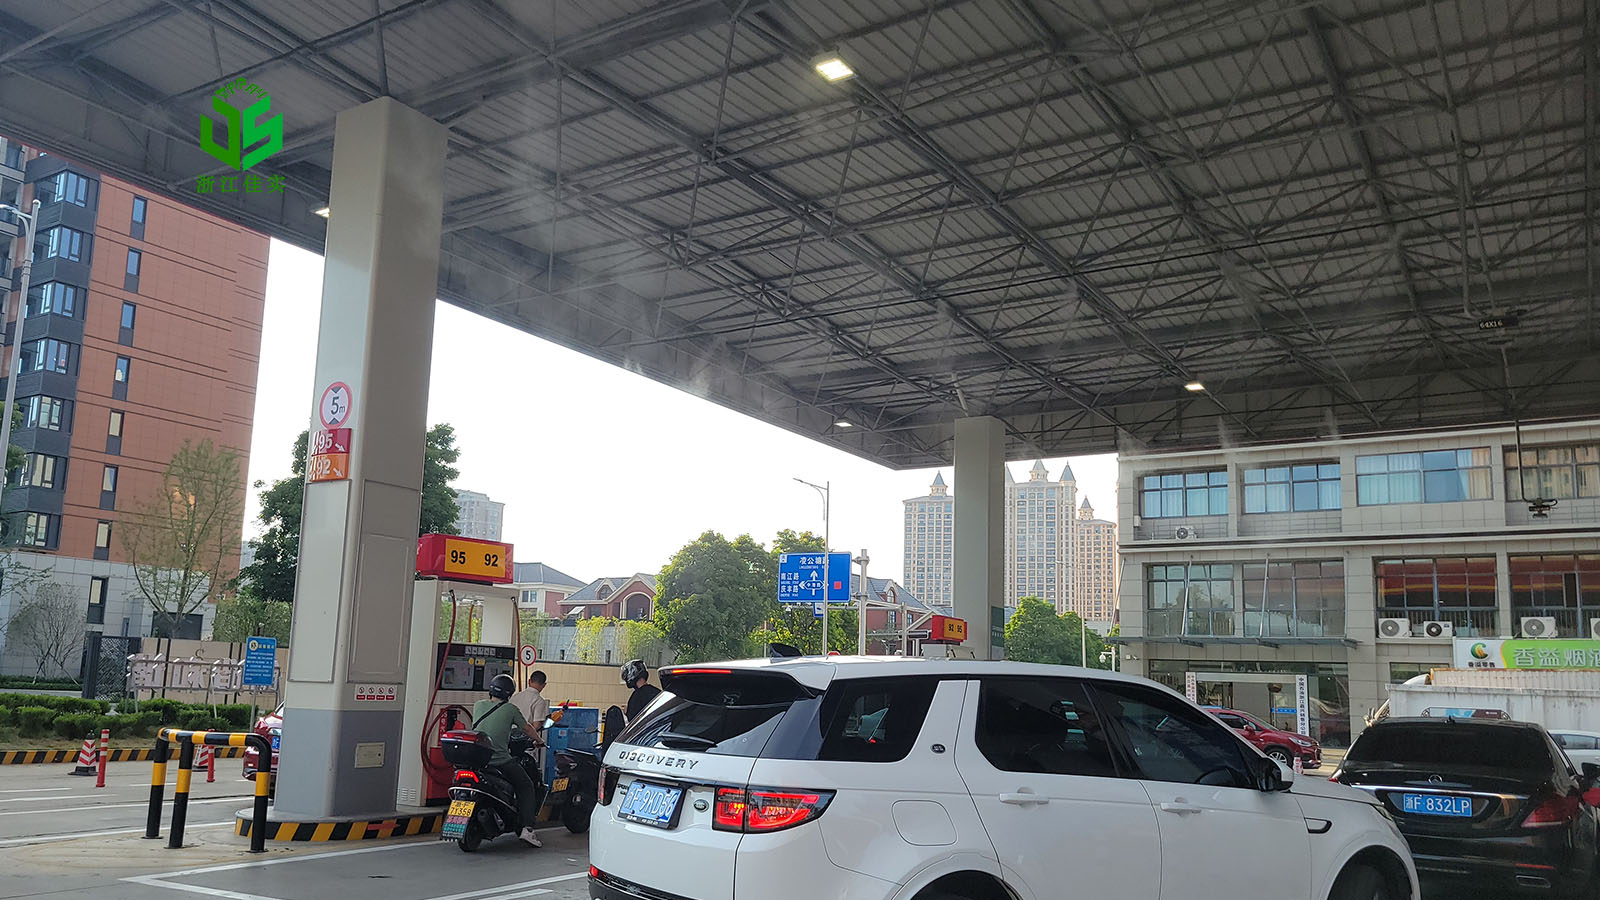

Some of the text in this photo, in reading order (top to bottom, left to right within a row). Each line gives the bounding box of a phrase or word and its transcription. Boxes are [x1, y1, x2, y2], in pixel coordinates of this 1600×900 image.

[450, 550, 499, 567] 95 92
[948, 624, 962, 633] 92 95
[525, 651, 531, 660] 5
[619, 751, 699, 770] DISCOVERY
